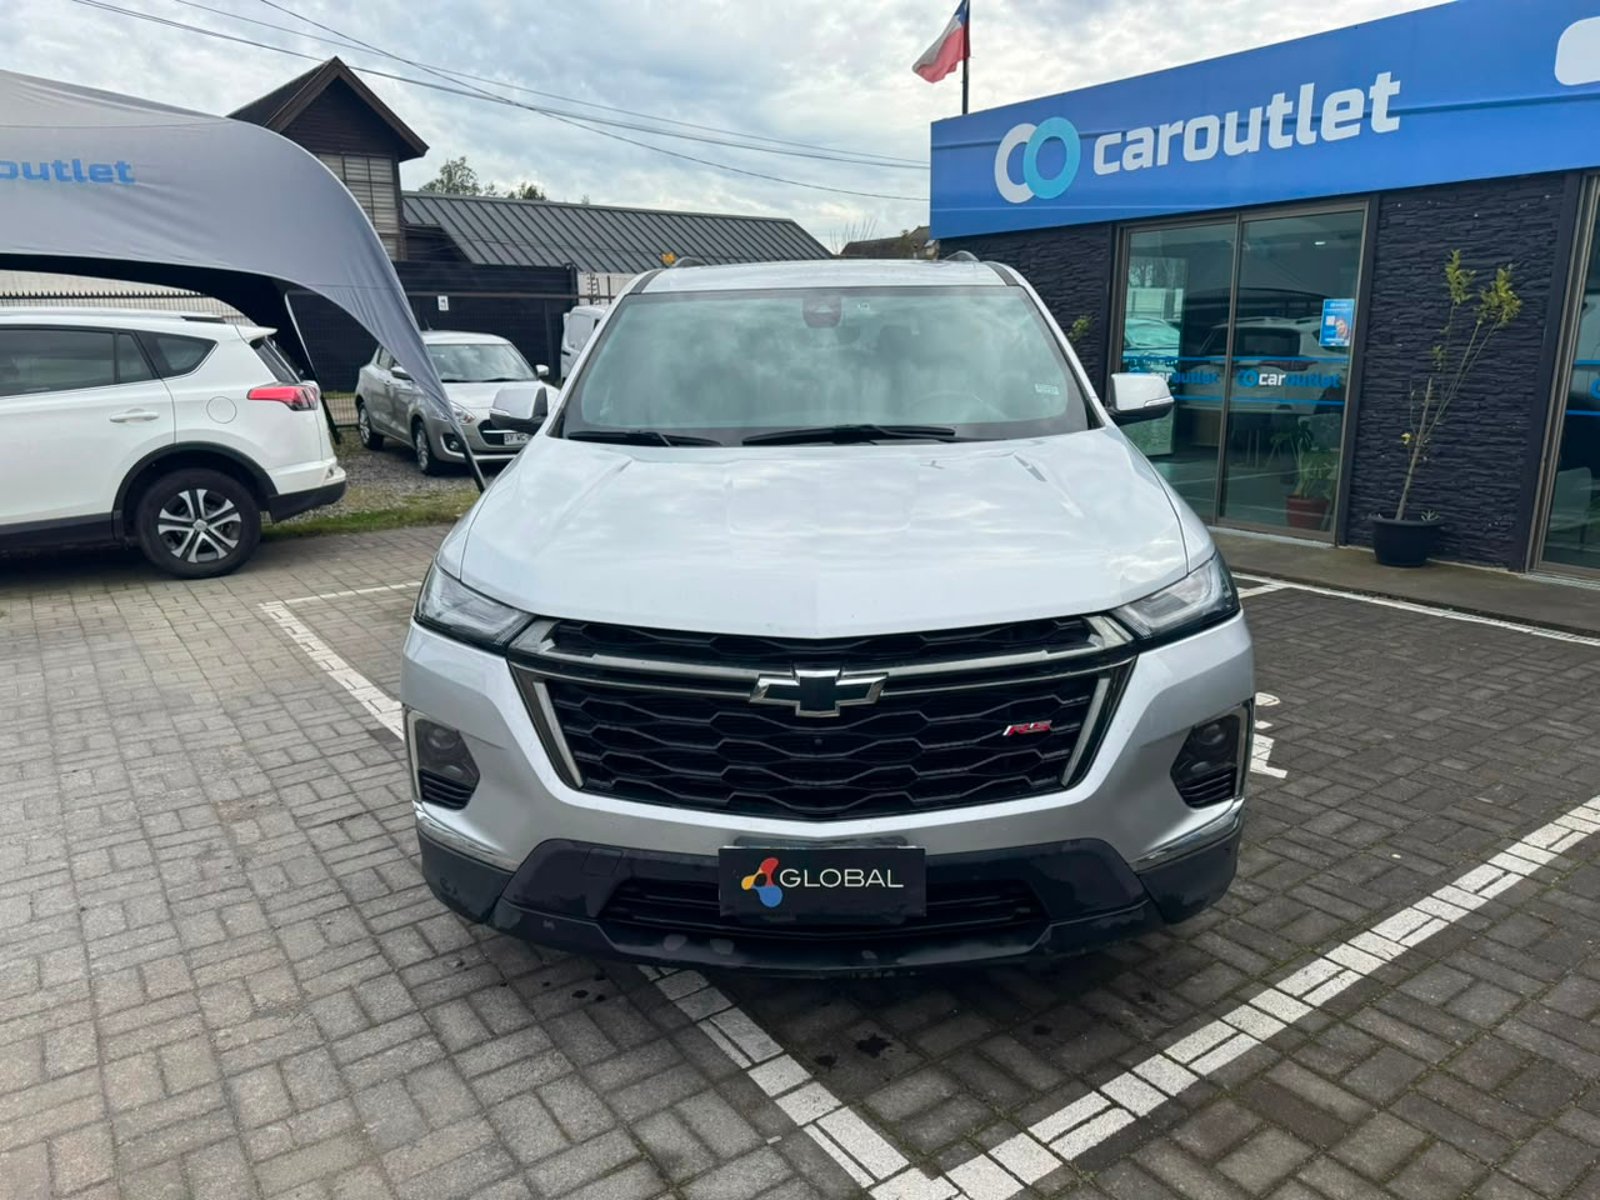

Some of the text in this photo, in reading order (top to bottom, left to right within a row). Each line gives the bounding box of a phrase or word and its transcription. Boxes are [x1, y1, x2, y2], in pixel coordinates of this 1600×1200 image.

[1093, 71, 1401, 176] caroutlet
[1258, 372, 1340, 388] caroutlet
[1002, 719, 1052, 736] RS
[779, 868, 904, 888] GLOBAL
